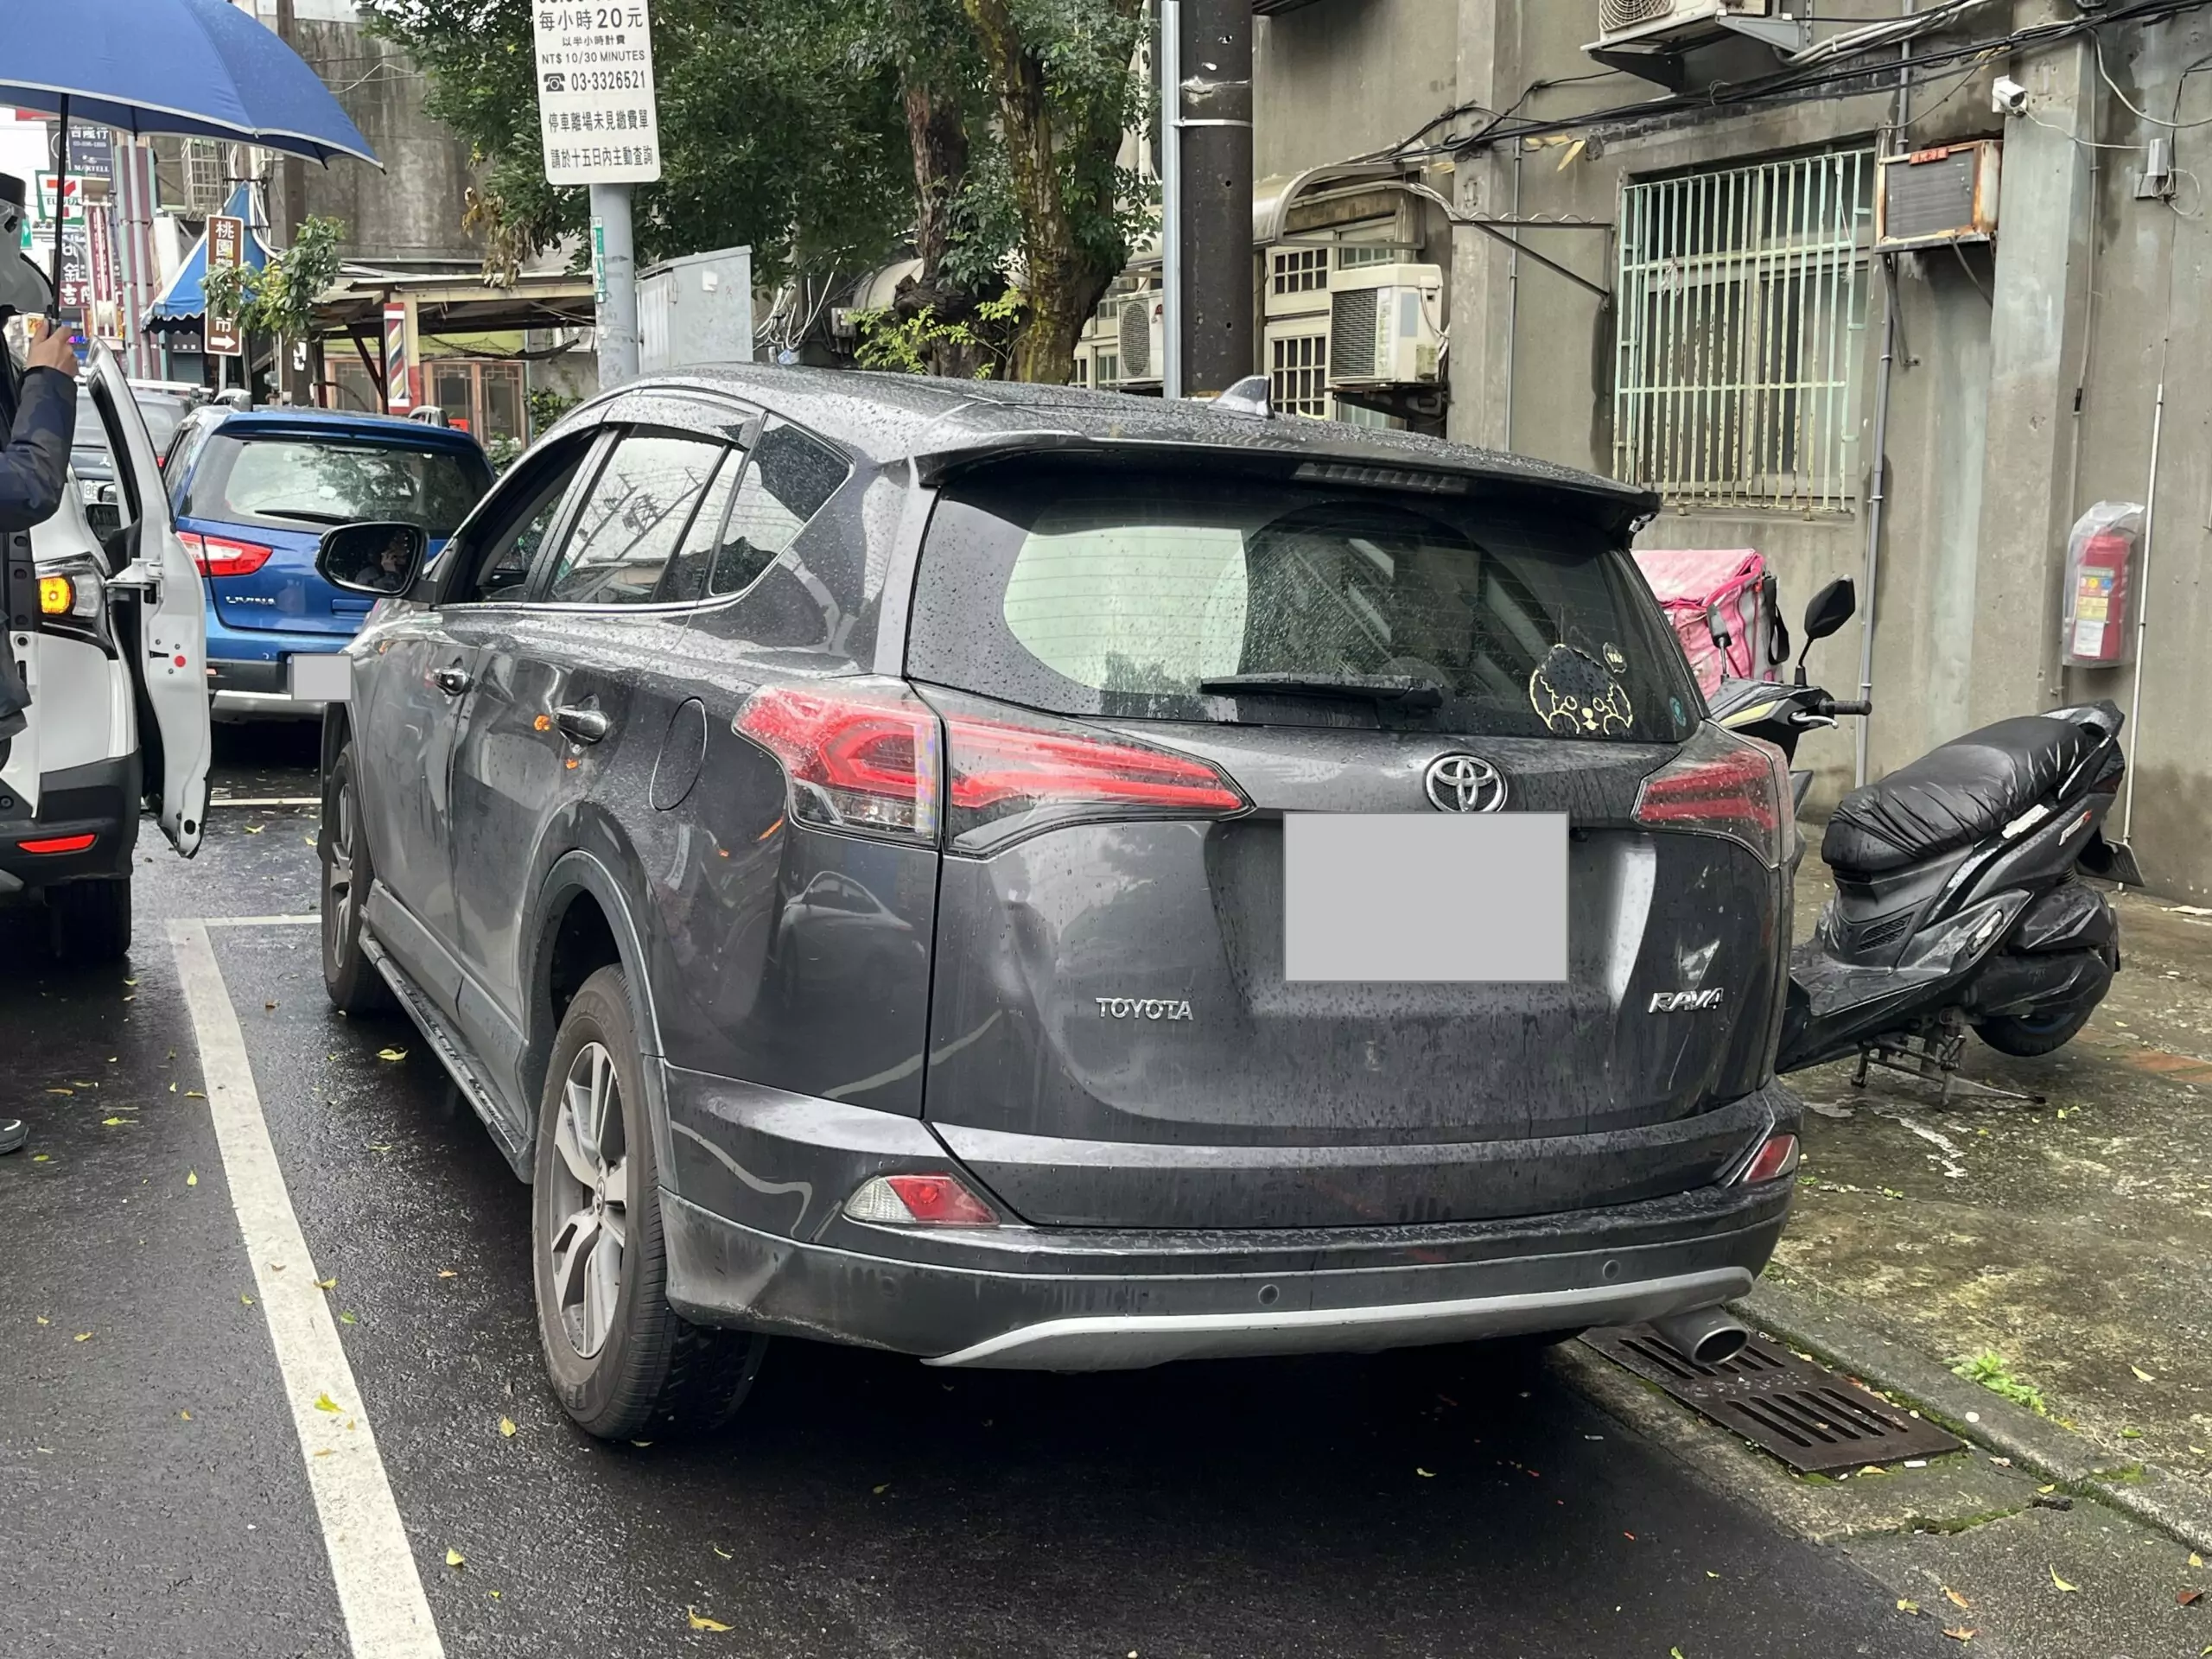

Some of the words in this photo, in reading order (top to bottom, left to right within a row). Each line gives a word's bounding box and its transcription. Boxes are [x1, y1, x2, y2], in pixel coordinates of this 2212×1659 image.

[539, 7, 644, 32] 每小時20元
[542, 53, 563, 65] NT$
[566, 51, 598, 65] 10/30
[601, 50, 645, 62] MINUTES
[549, 109, 649, 133] 停車離場未見繳費單
[550, 145, 653, 168] 請於十五日內主動查詢
[1095, 997, 1193, 1020] TOYOTA
[1649, 987, 1724, 1013] RAV4
